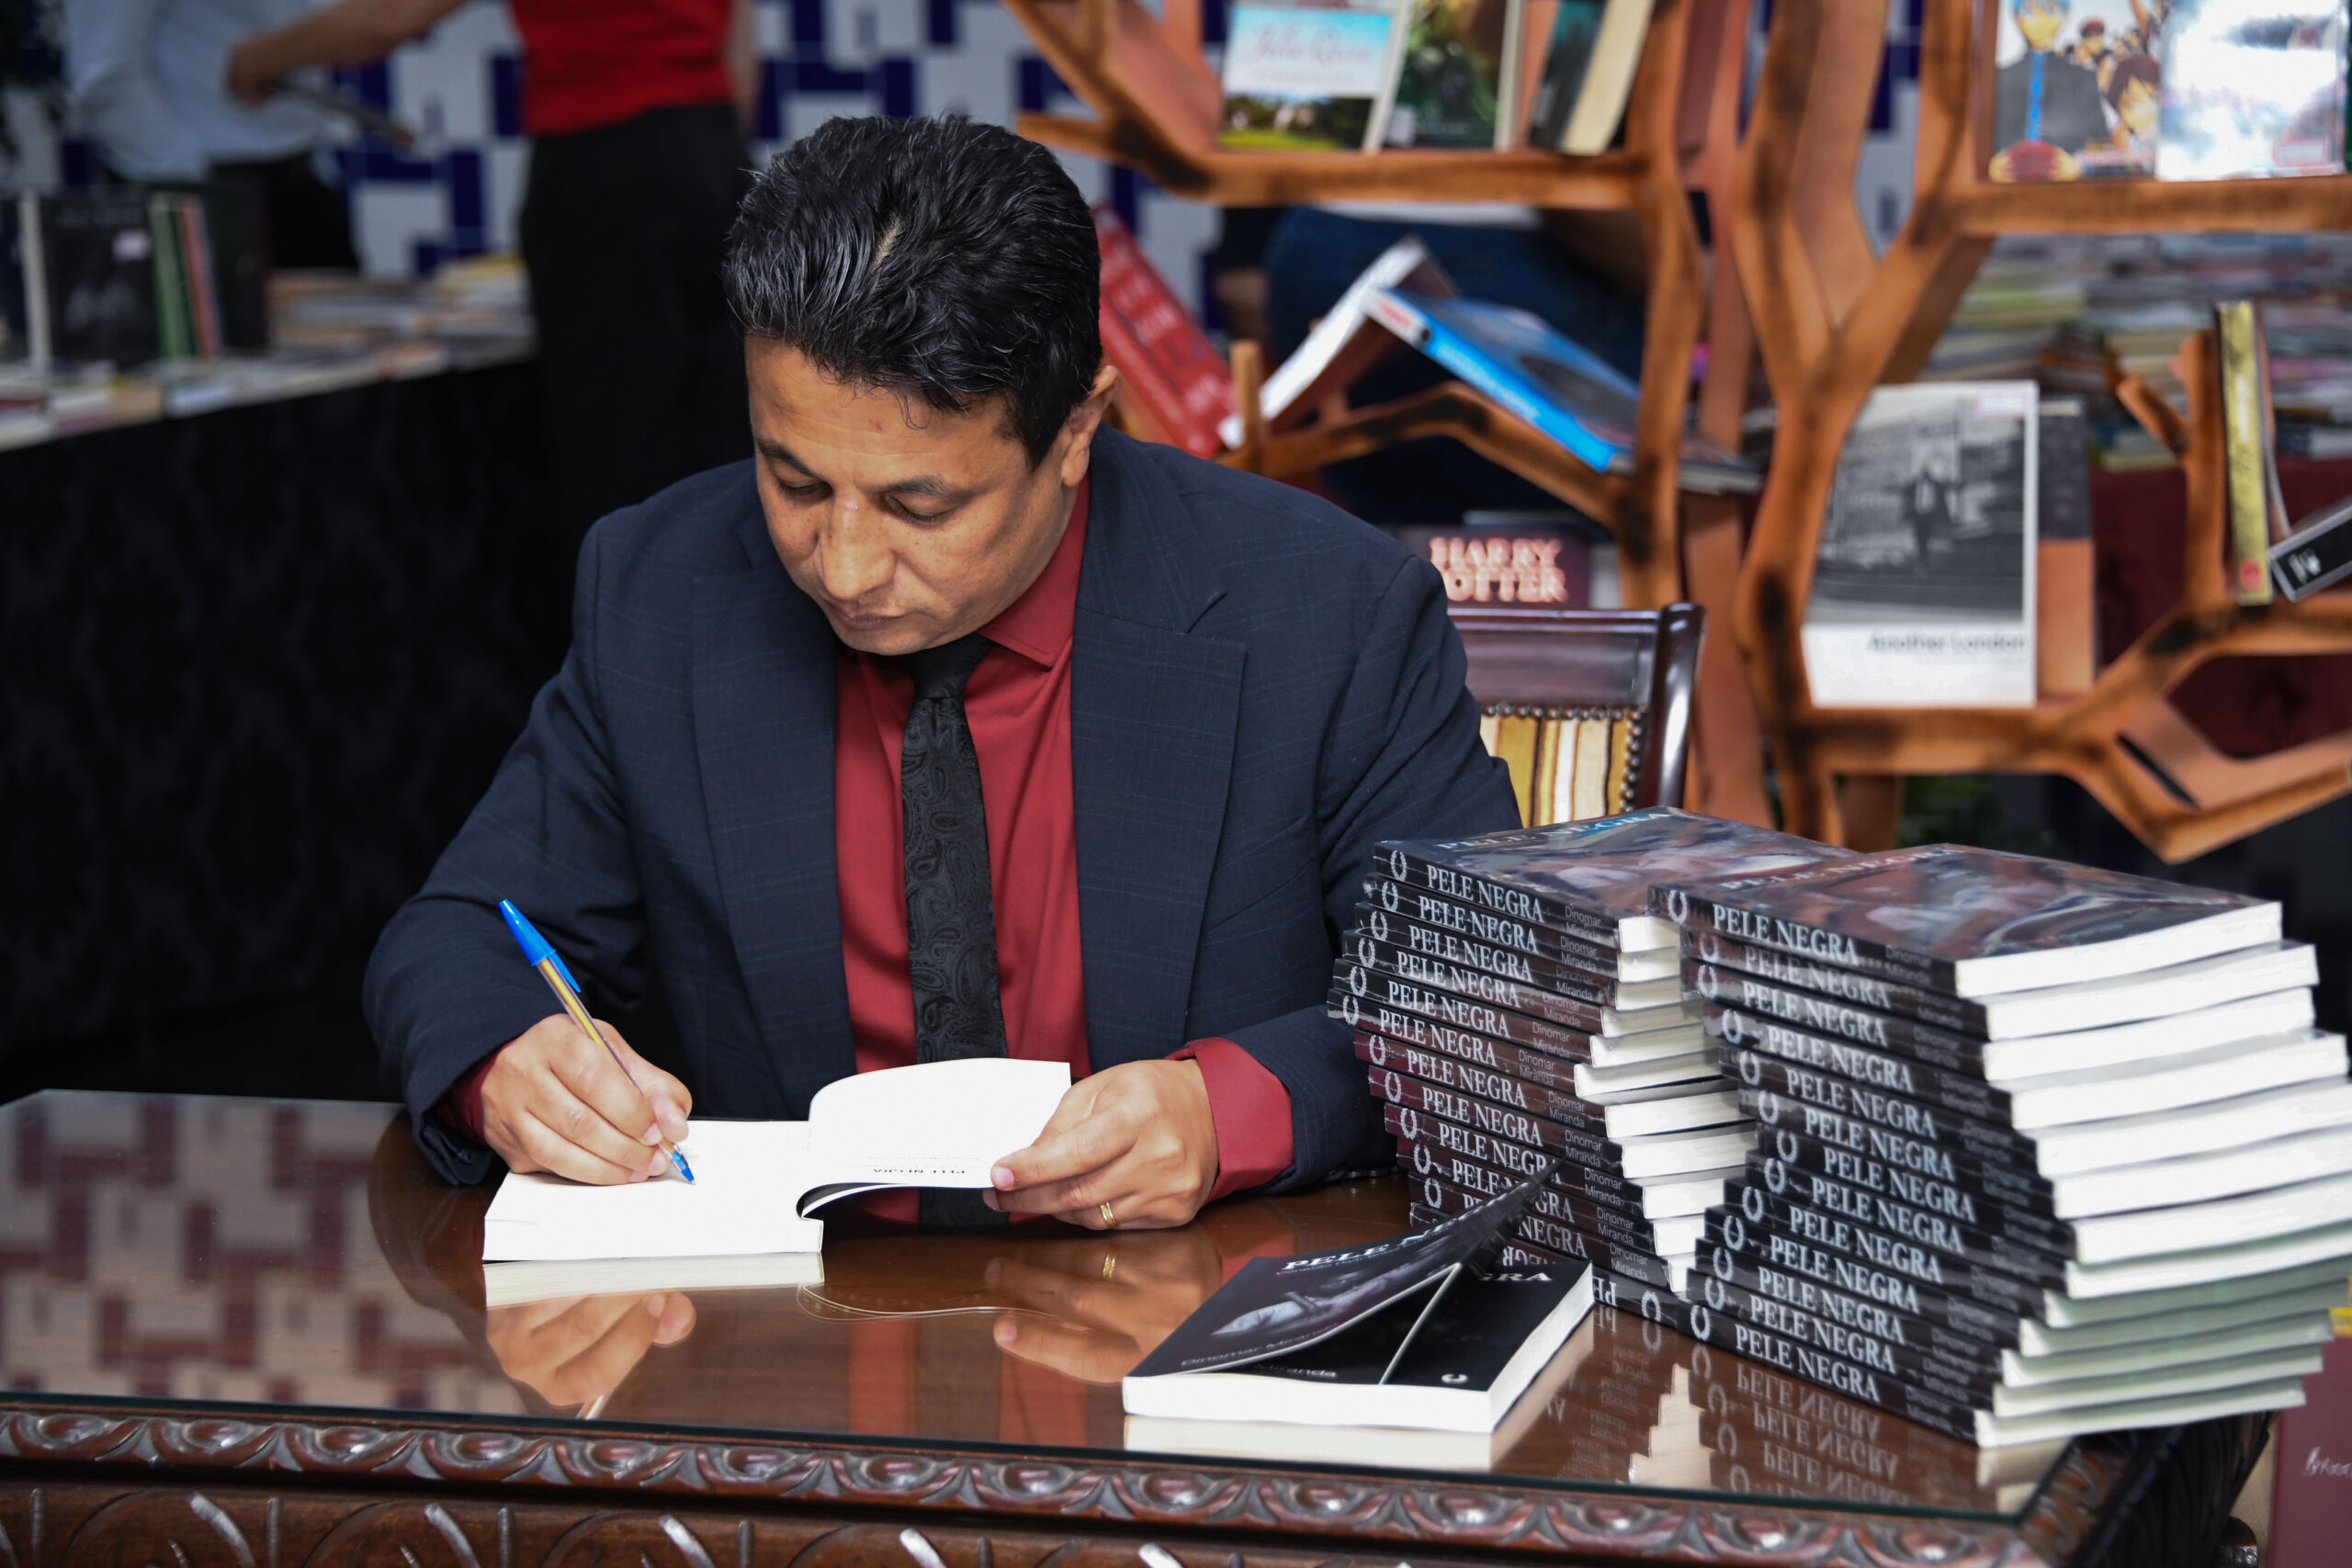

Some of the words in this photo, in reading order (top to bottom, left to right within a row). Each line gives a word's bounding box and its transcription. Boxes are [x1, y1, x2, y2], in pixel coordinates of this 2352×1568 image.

[1430, 536, 1563, 570] HARRY
[1427, 864, 1473, 901] PELE
[1477, 880, 1544, 923] NEGRA
[1419, 896, 1465, 931] PELE
[1471, 911, 1539, 953] NEGRA
[1566, 906, 1600, 926] Dinomar
[1561, 936, 1597, 956] Dinomar
[1713, 904, 1770, 942] PELE
[1775, 919, 1860, 965] NEGRA
[1408, 925, 1458, 959] PELE
[1463, 941, 1533, 983] NEGRA
[1562, 953, 1596, 972] Miranda
[1396, 951, 1446, 986] PELE
[1450, 966, 1521, 1009] NEGRA
[1556, 981, 1593, 1001] Miranda
[1746, 945, 1801, 984] PELE
[1807, 963, 1891, 1010] NEGRA
[1388, 981, 1436, 1016] PELE
[1441, 997, 1510, 1038] NEGRA
[1543, 992, 1579, 1011] Dinomar
[1544, 1007, 1580, 1027] Miranda
[1742, 981, 1800, 1021] PELE
[1804, 998, 1888, 1047] NEGRA
[1379, 1009, 1425, 1044] PELE
[1430, 1025, 1498, 1066] NEGRA
[1532, 1021, 1570, 1042] Dinomar
[1534, 1038, 1570, 1057] Miranda
[1519, 1050, 1555, 1070] Dinomar
[1520, 1066, 1554, 1085] Miranda
[1768, 1025, 1825, 1066] PELE
[1830, 1043, 1915, 1094] NEGRA
[1407, 1049, 1454, 1086] PELE
[1458, 1066, 1527, 1108] NEGRA
[1422, 1087, 1470, 1122] PELE
[1474, 1103, 1544, 1146] NEGRA
[1548, 1091, 1585, 1111] Dinomar
[1550, 1108, 1585, 1128] Miranda
[1785, 1066, 1846, 1111] PELE
[1849, 1088, 1938, 1140] NEGRA
[1439, 1122, 1487, 1159] PELE
[1565, 1130, 1602, 1151] Dinomar
[1566, 1146, 1600, 1168] Miranda
[1803, 1106, 1864, 1151] PELE
[1868, 1127, 1955, 1182] NEGRA
[1585, 1168, 1622, 1190] Dinomar
[1585, 1185, 1622, 1206] Miranda
[1823, 1146, 1883, 1191] PELE
[1887, 1168, 1976, 1223] NEGRA
[1597, 1207, 1634, 1230] Dinomar
[1811, 1176, 1872, 1223] PELE
[1875, 1198, 1964, 1254] NEGRA
[1598, 1224, 1634, 1245] Miranda
[1789, 1205, 1849, 1251] PELE
[1854, 1228, 1942, 1284] NEGRA
[1282, 1243, 1390, 1271] PELE
[1610, 1243, 1647, 1265] Dinomar
[1611, 1258, 1647, 1280] Miranda
[1770, 1235, 1829, 1280] PELE
[1833, 1257, 1920, 1314] NEGRA
[1758, 1266, 1815, 1312] PELE
[1821, 1289, 1905, 1345] NEGRA
[1749, 1294, 1807, 1340] PELE
[1813, 1317, 1895, 1374] NEGRA
[1735, 1324, 1792, 1369] PELE
[1796, 1347, 1880, 1403] NEGRA
